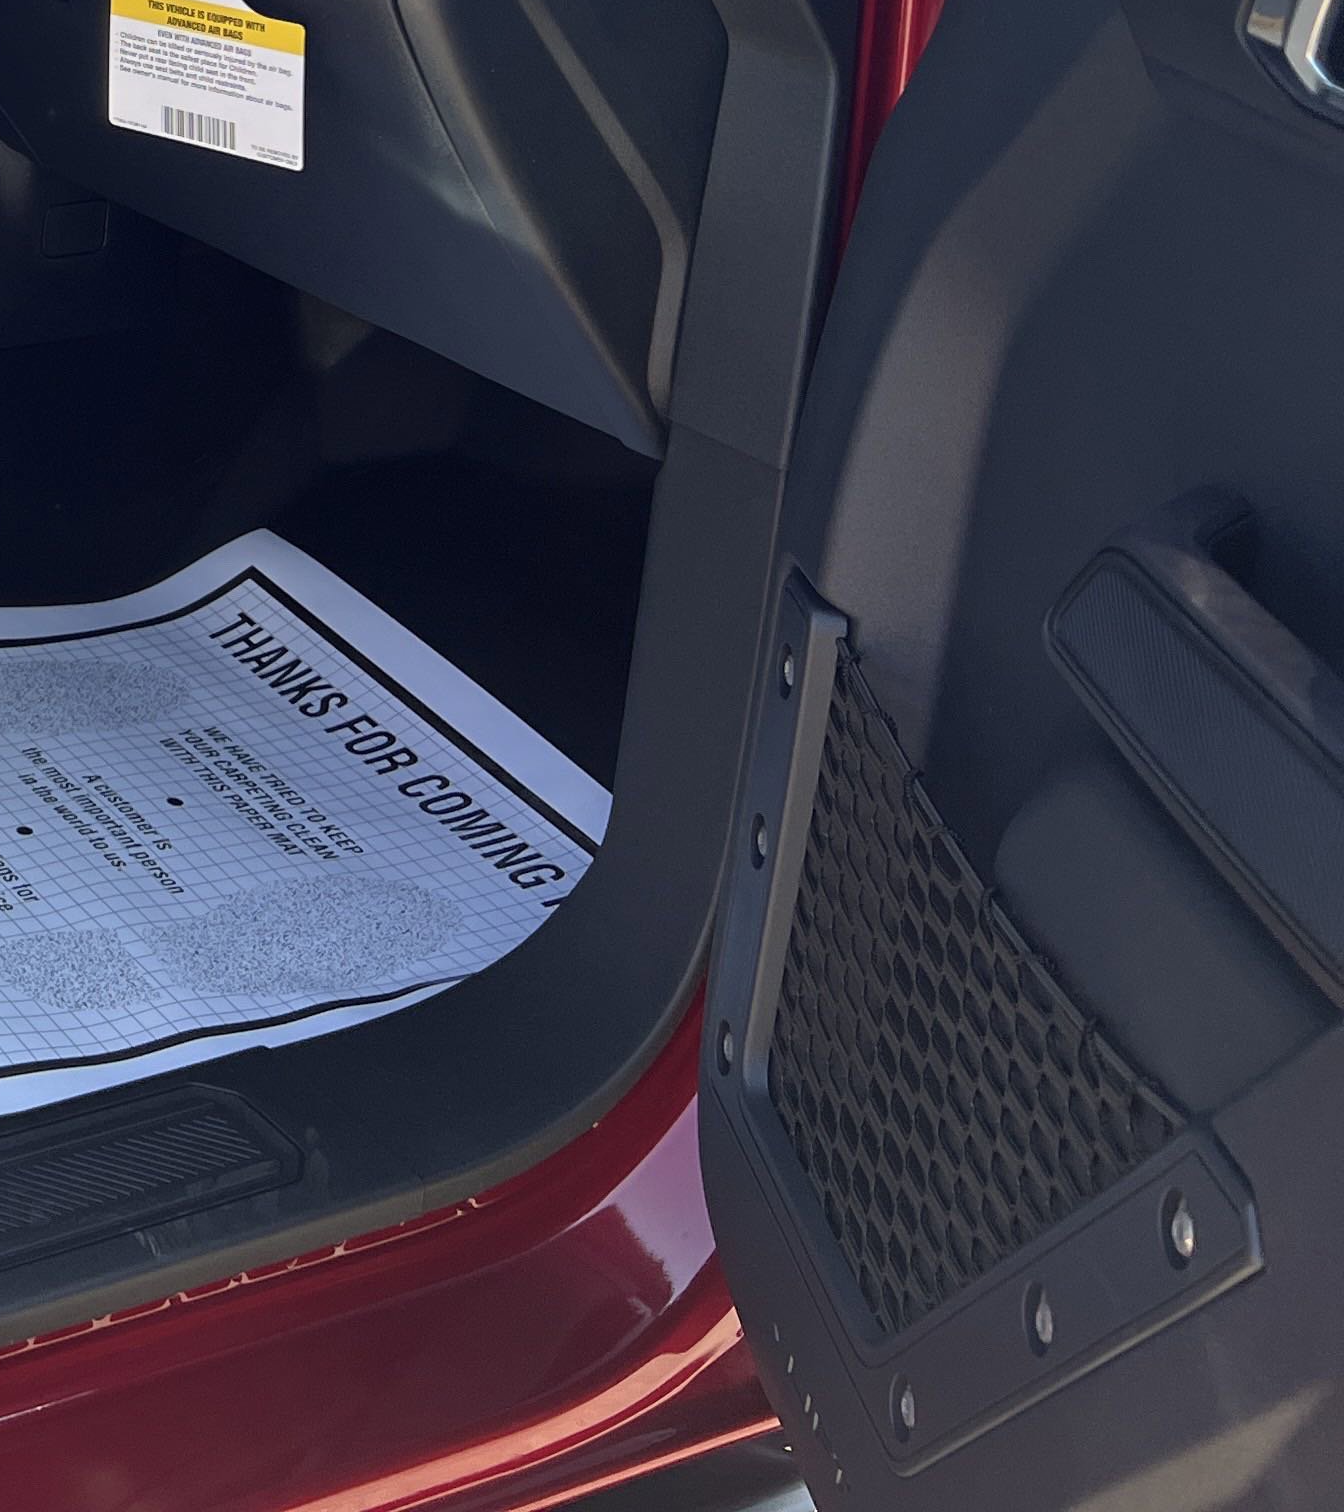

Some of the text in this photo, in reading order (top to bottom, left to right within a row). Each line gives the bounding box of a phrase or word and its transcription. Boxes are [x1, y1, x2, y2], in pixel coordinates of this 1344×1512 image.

[148, 0, 265, 32] THIS VEHICLE IS EQUIPPED WITH
[167, 17, 244, 40] ADVANCED AIR BAGS
[159, 737, 308, 857] WITH THIS PAPER MAT
[178, 729, 340, 861] YOUR CARPETING CLEAN
[203, 726, 365, 855] WE HAVE TRIED TO KEEP
[209, 611, 566, 890] THANKS FOR COMING
[18, 773, 127, 872] in the world to us.
[22, 747, 185, 895] the most important person
[82, 774, 172, 851] A customer is
[12, 883, 40, 903] for
